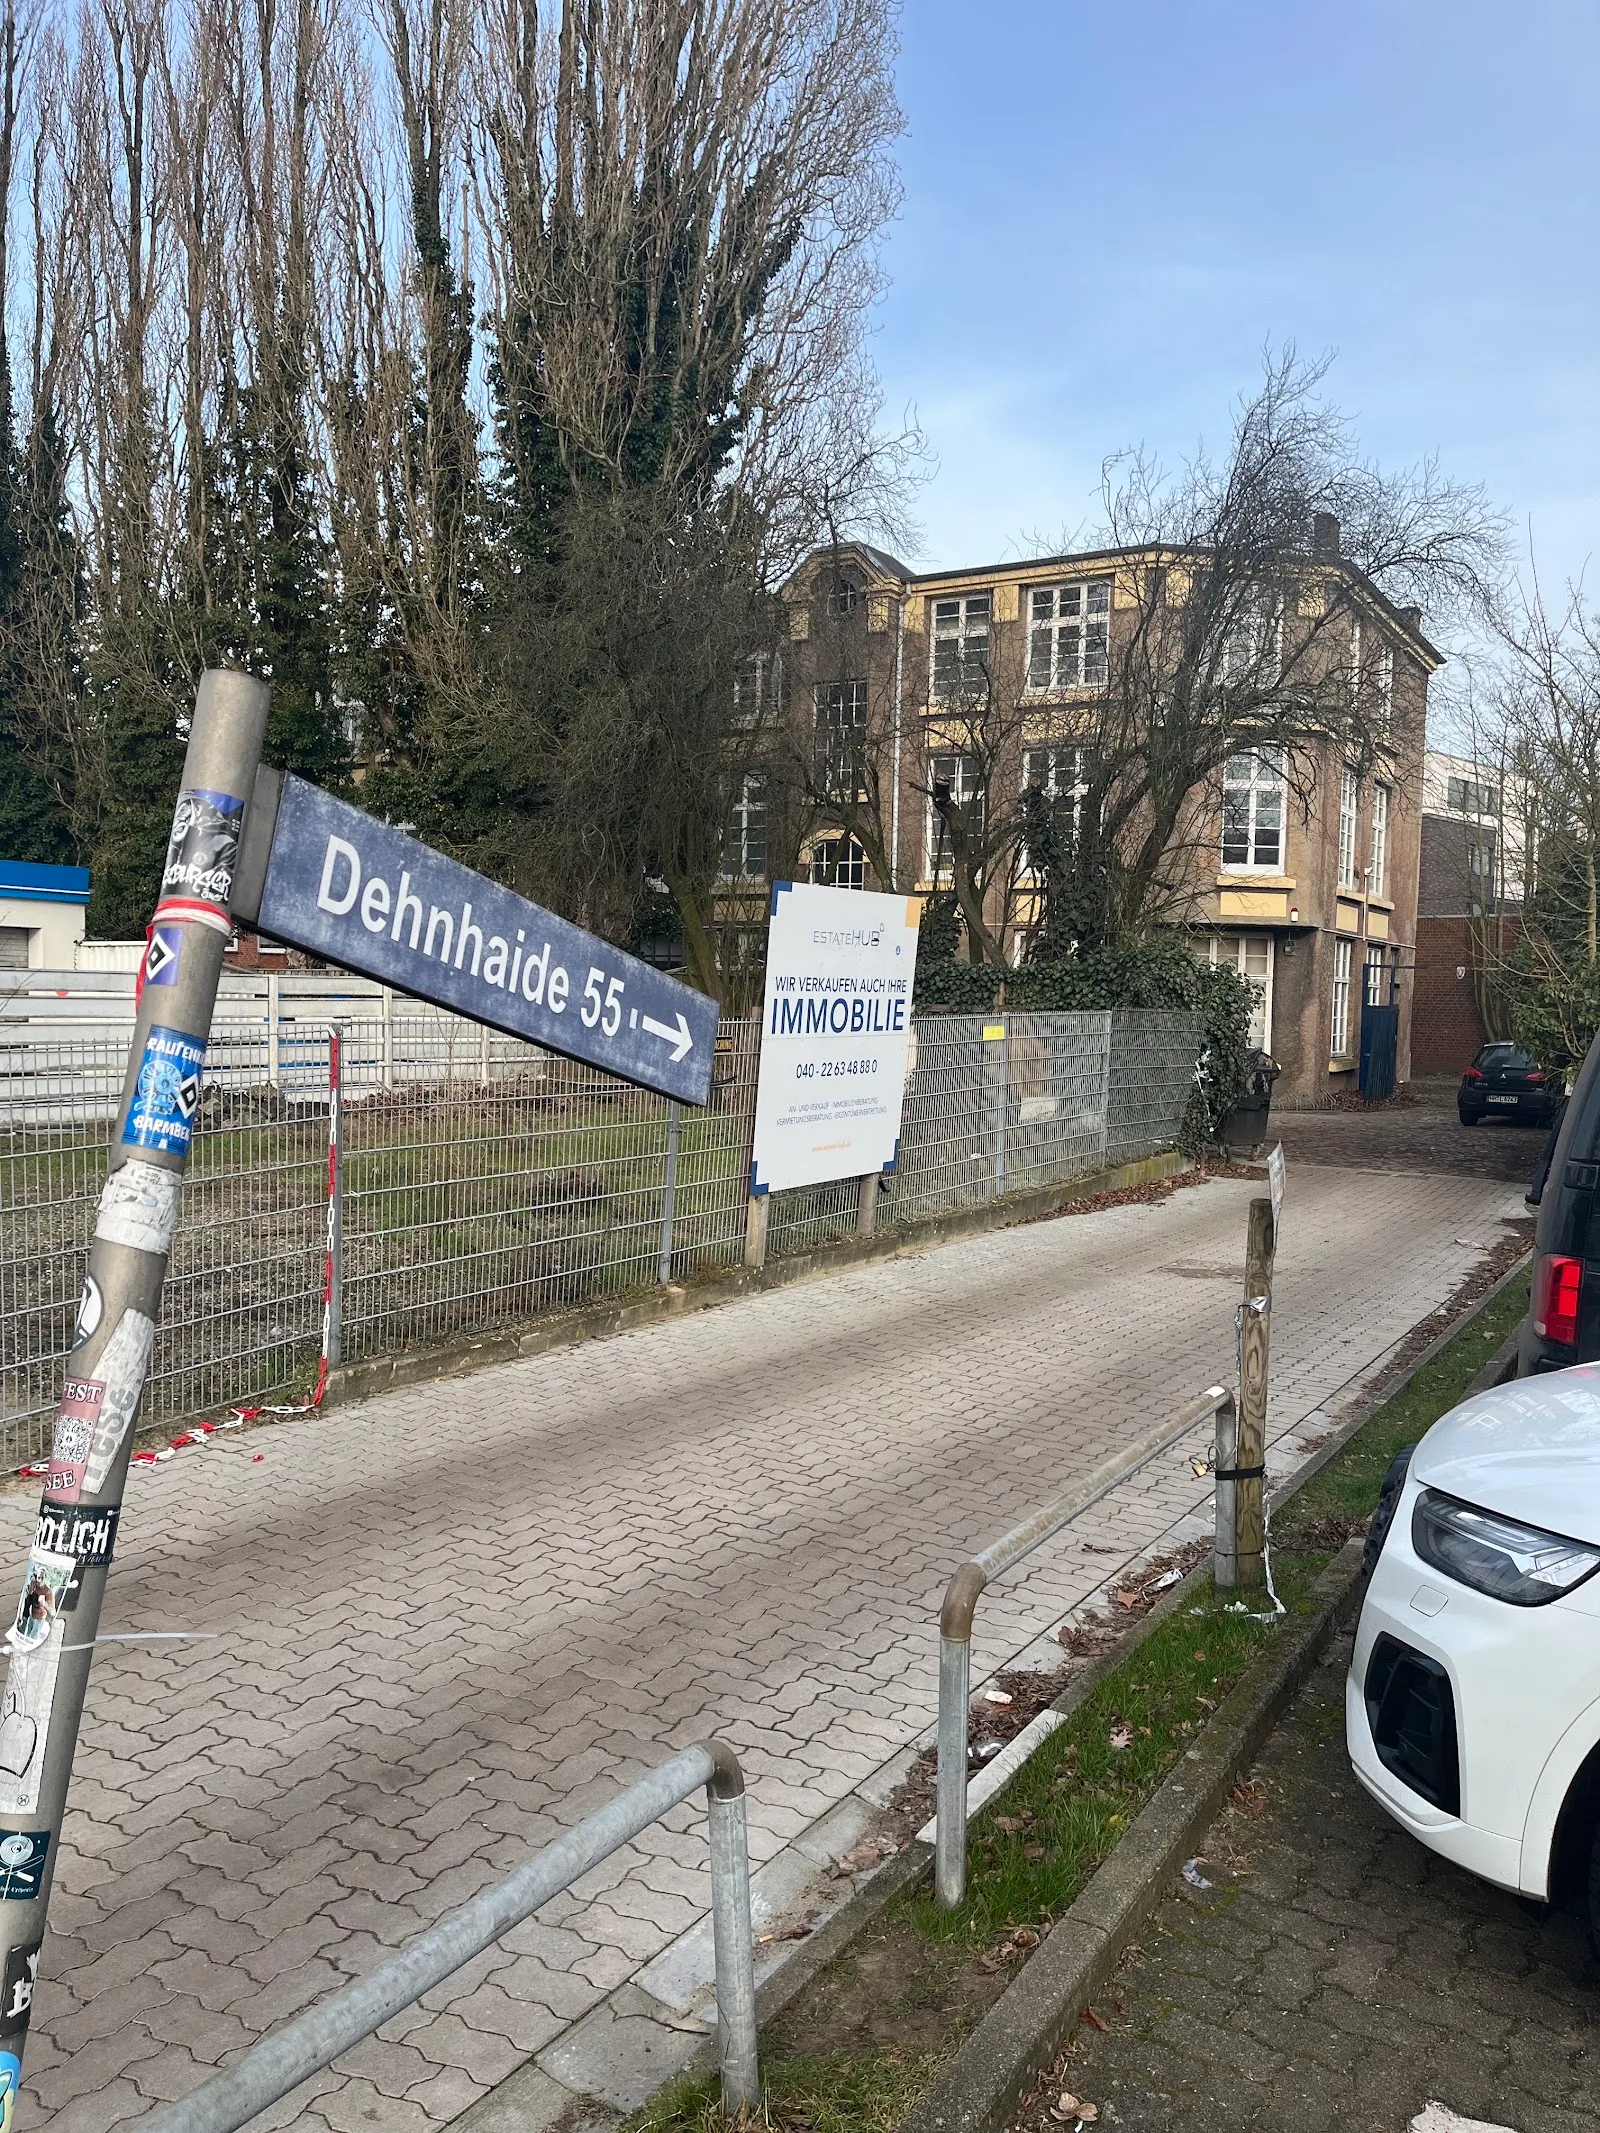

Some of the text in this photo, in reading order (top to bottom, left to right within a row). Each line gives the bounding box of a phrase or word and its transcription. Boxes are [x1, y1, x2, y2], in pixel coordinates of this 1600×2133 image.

[316, 834, 626, 1037] Dehnhaide 55
[775, 976, 908, 993] WIR VERKAUFEN AUCH IHRE
[771, 997, 906, 1035] IMMOBILIE
[796, 1063, 815, 1079] 040
